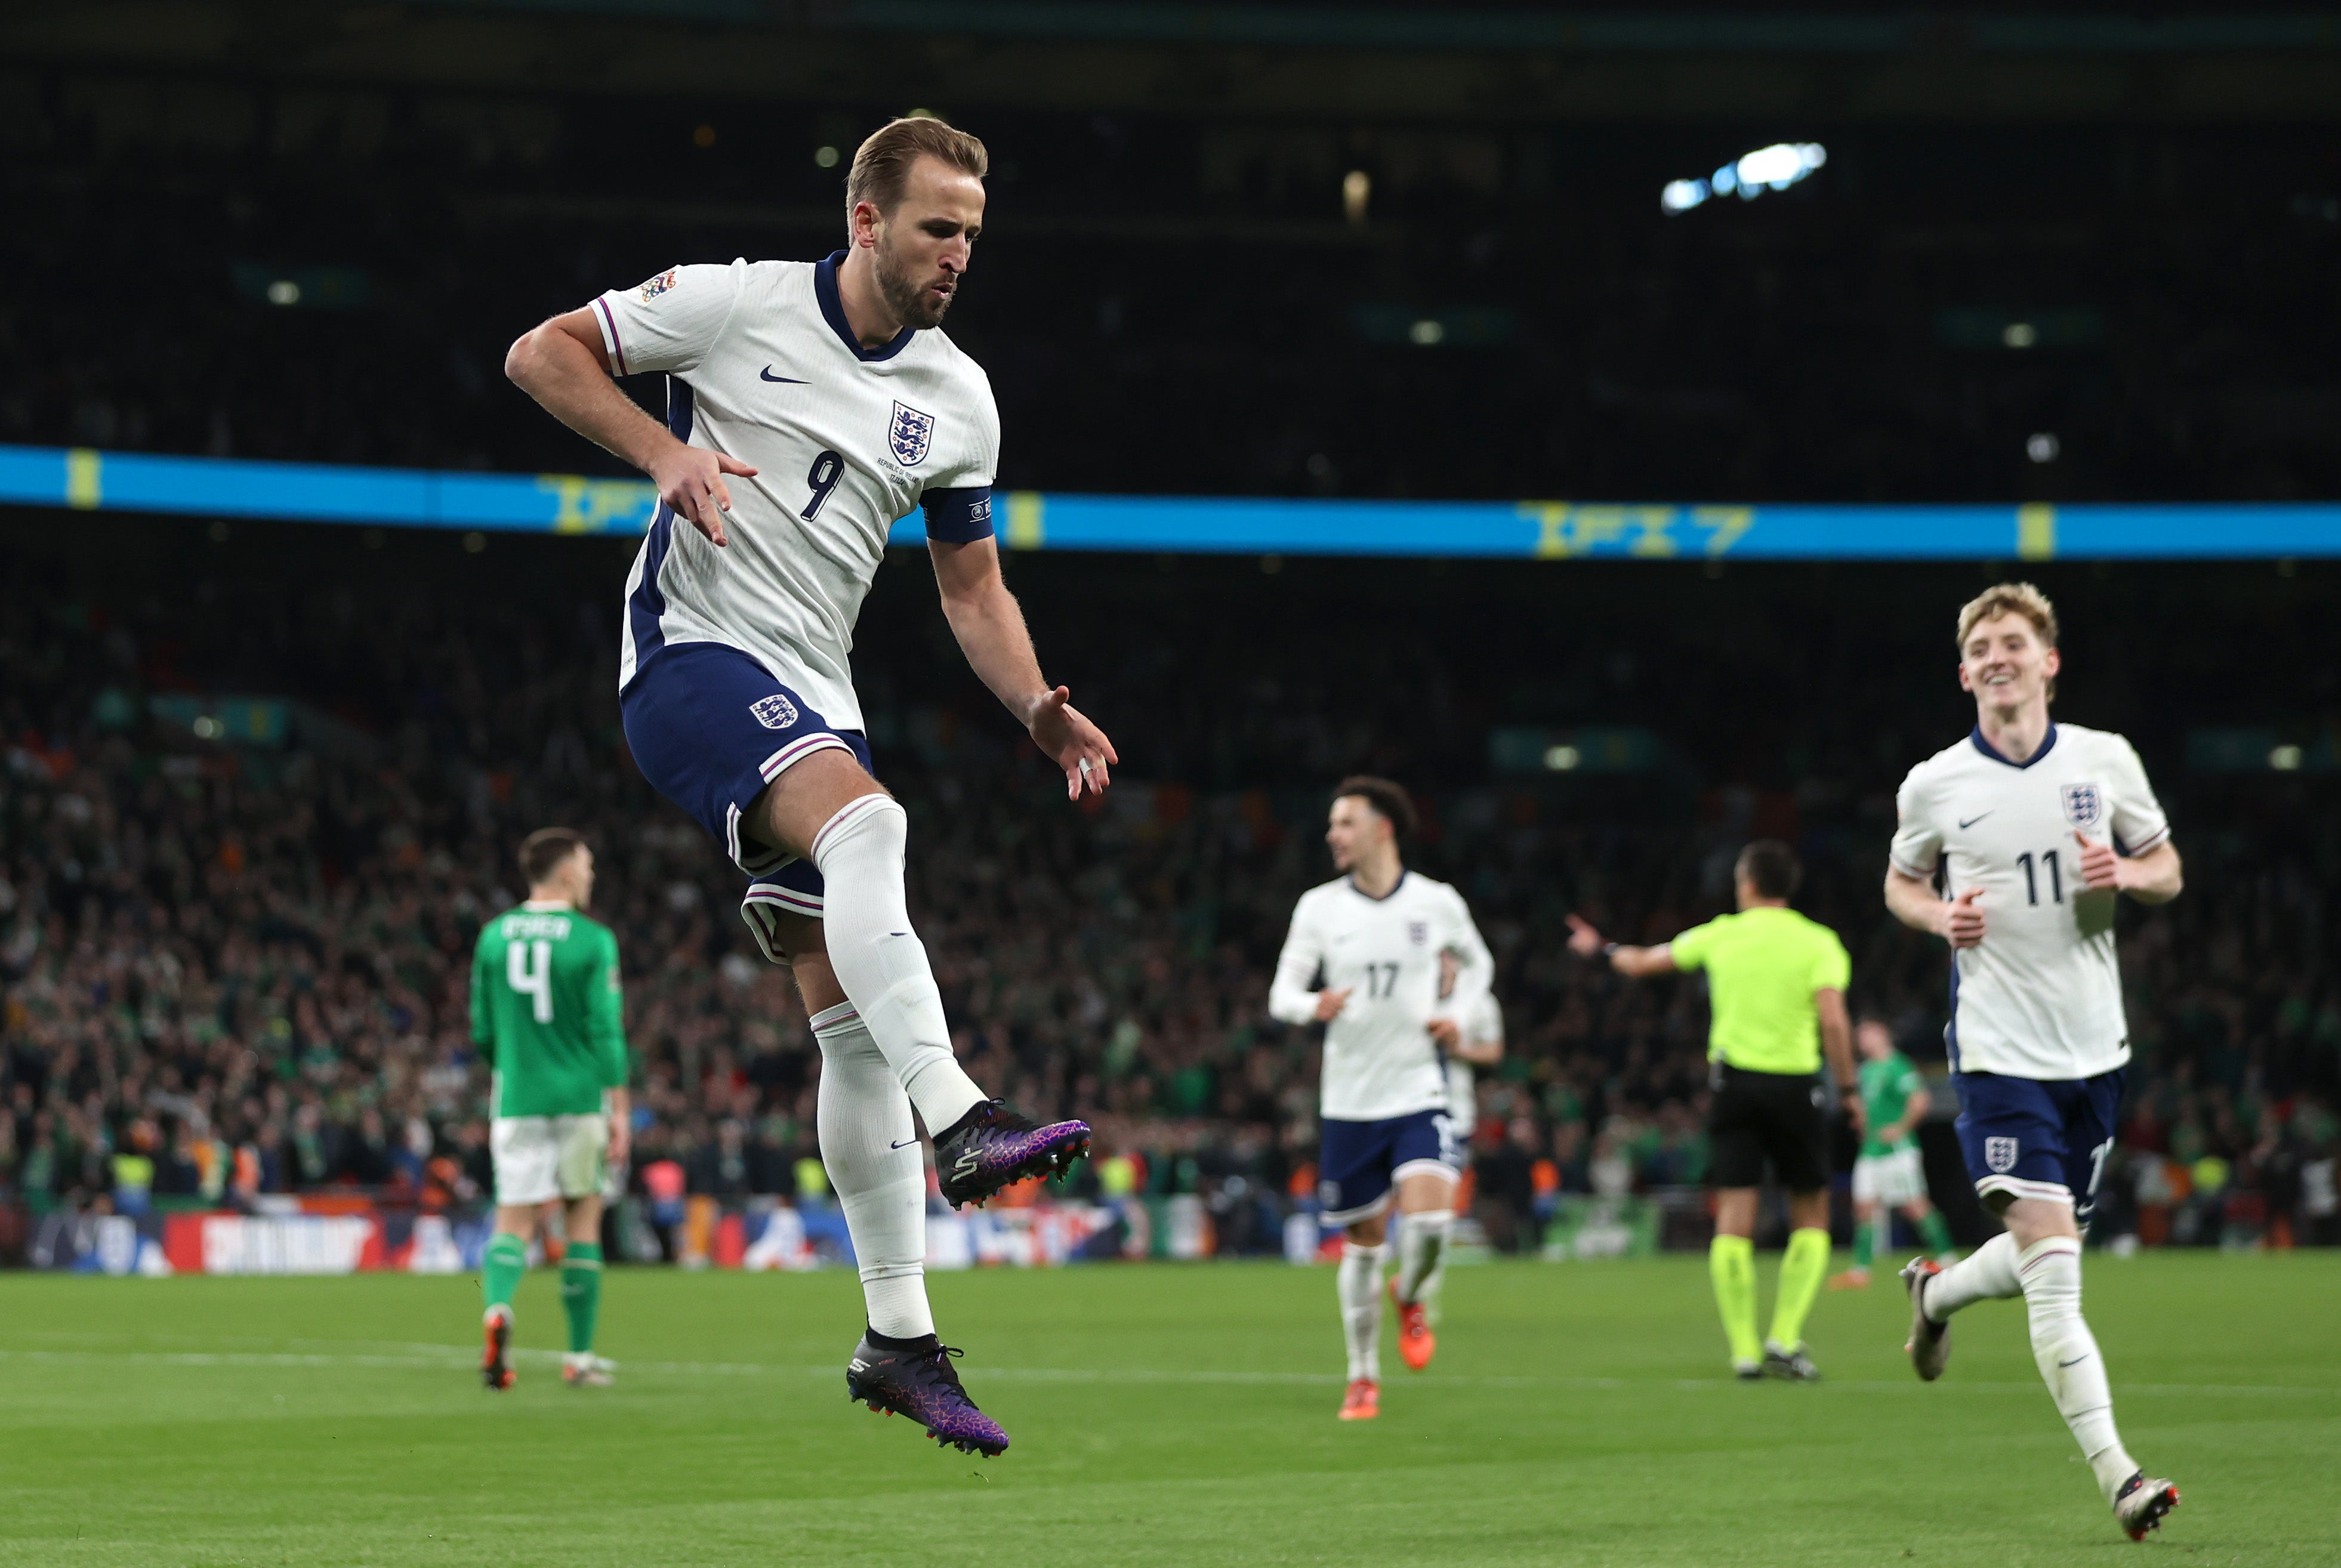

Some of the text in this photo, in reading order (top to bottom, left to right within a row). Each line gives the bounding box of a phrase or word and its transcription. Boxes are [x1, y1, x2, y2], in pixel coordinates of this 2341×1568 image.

[800, 450, 844, 522] 9
[877, 457, 899, 473] REPUBLIC
[2015, 848, 2064, 906] 11
[507, 939, 554, 1024] 4
[1365, 961, 1401, 999] 17
